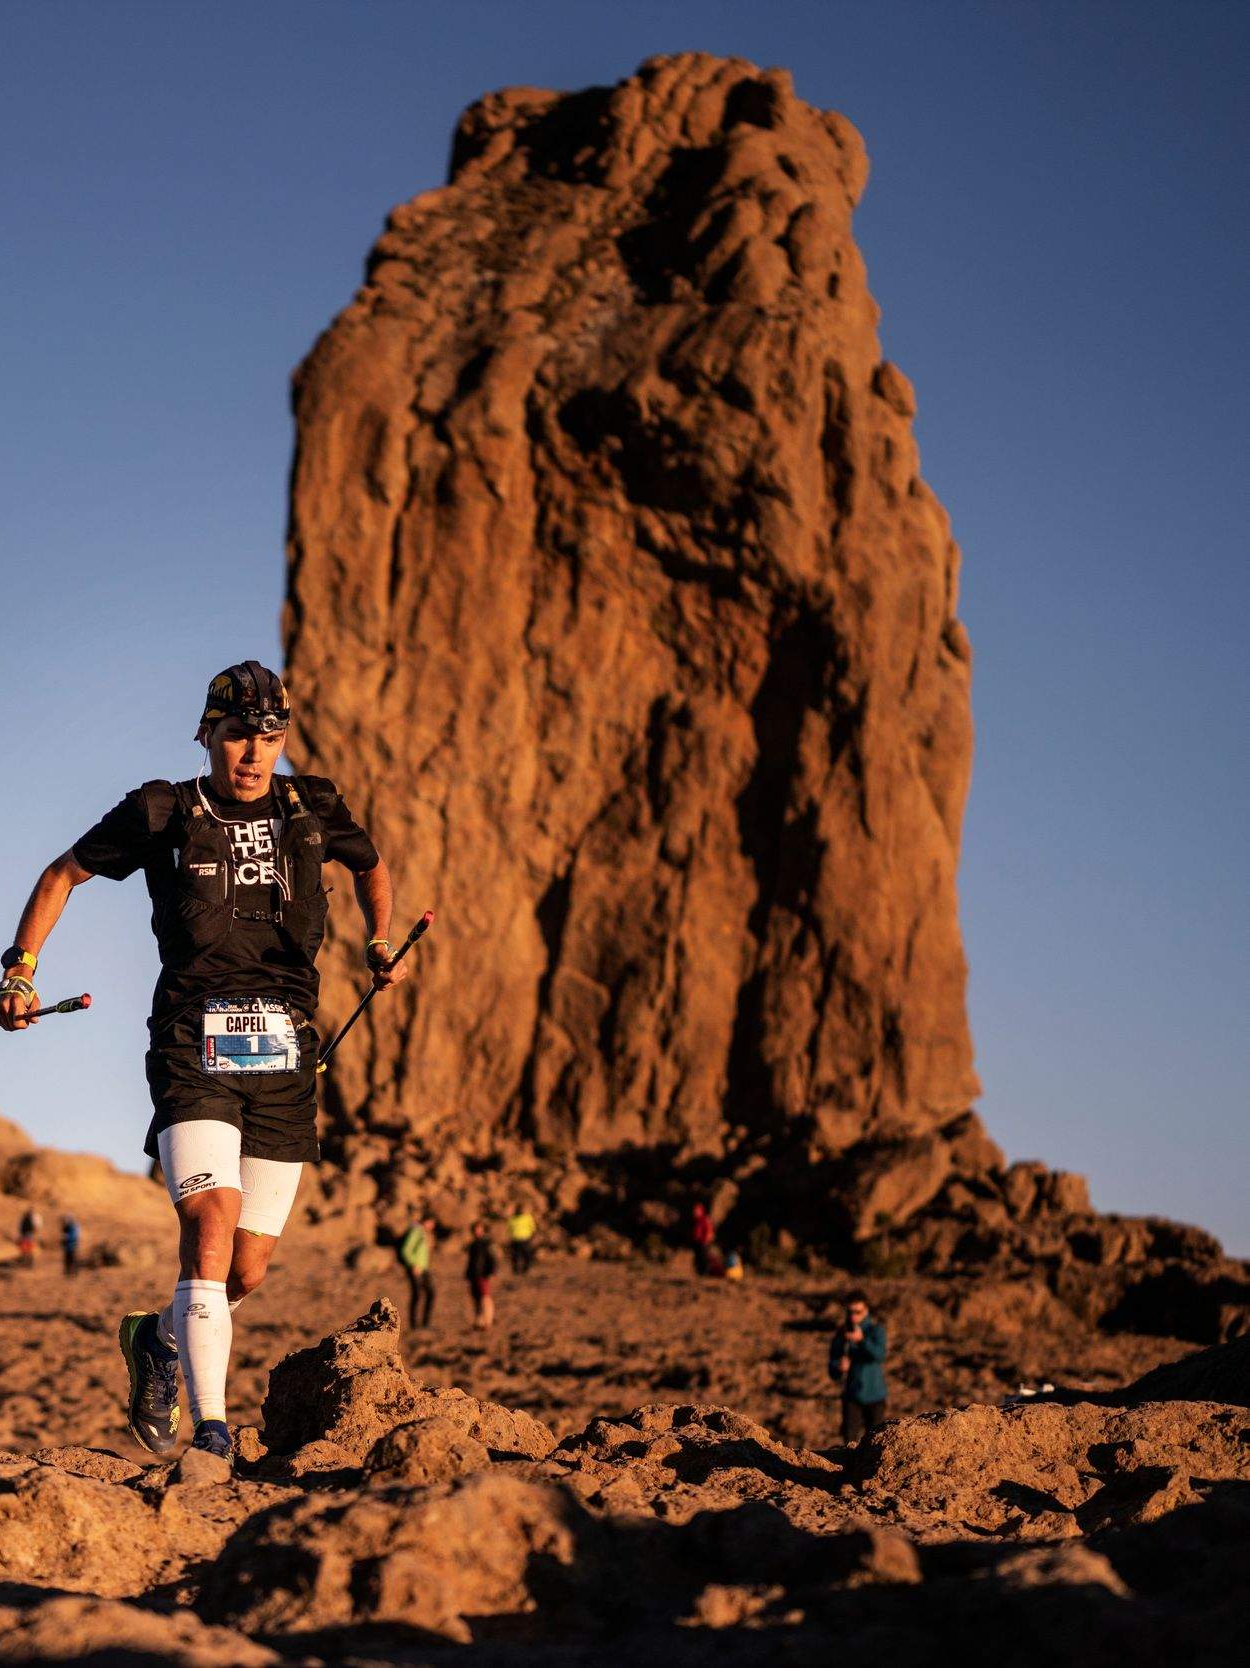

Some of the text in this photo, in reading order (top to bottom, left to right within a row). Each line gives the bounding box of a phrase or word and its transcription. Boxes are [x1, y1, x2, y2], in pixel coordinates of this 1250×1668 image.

[226, 1016, 268, 1033] CAPELL
[246, 1035, 259, 1053] 1
[190, 1181, 216, 1191] SPORT
